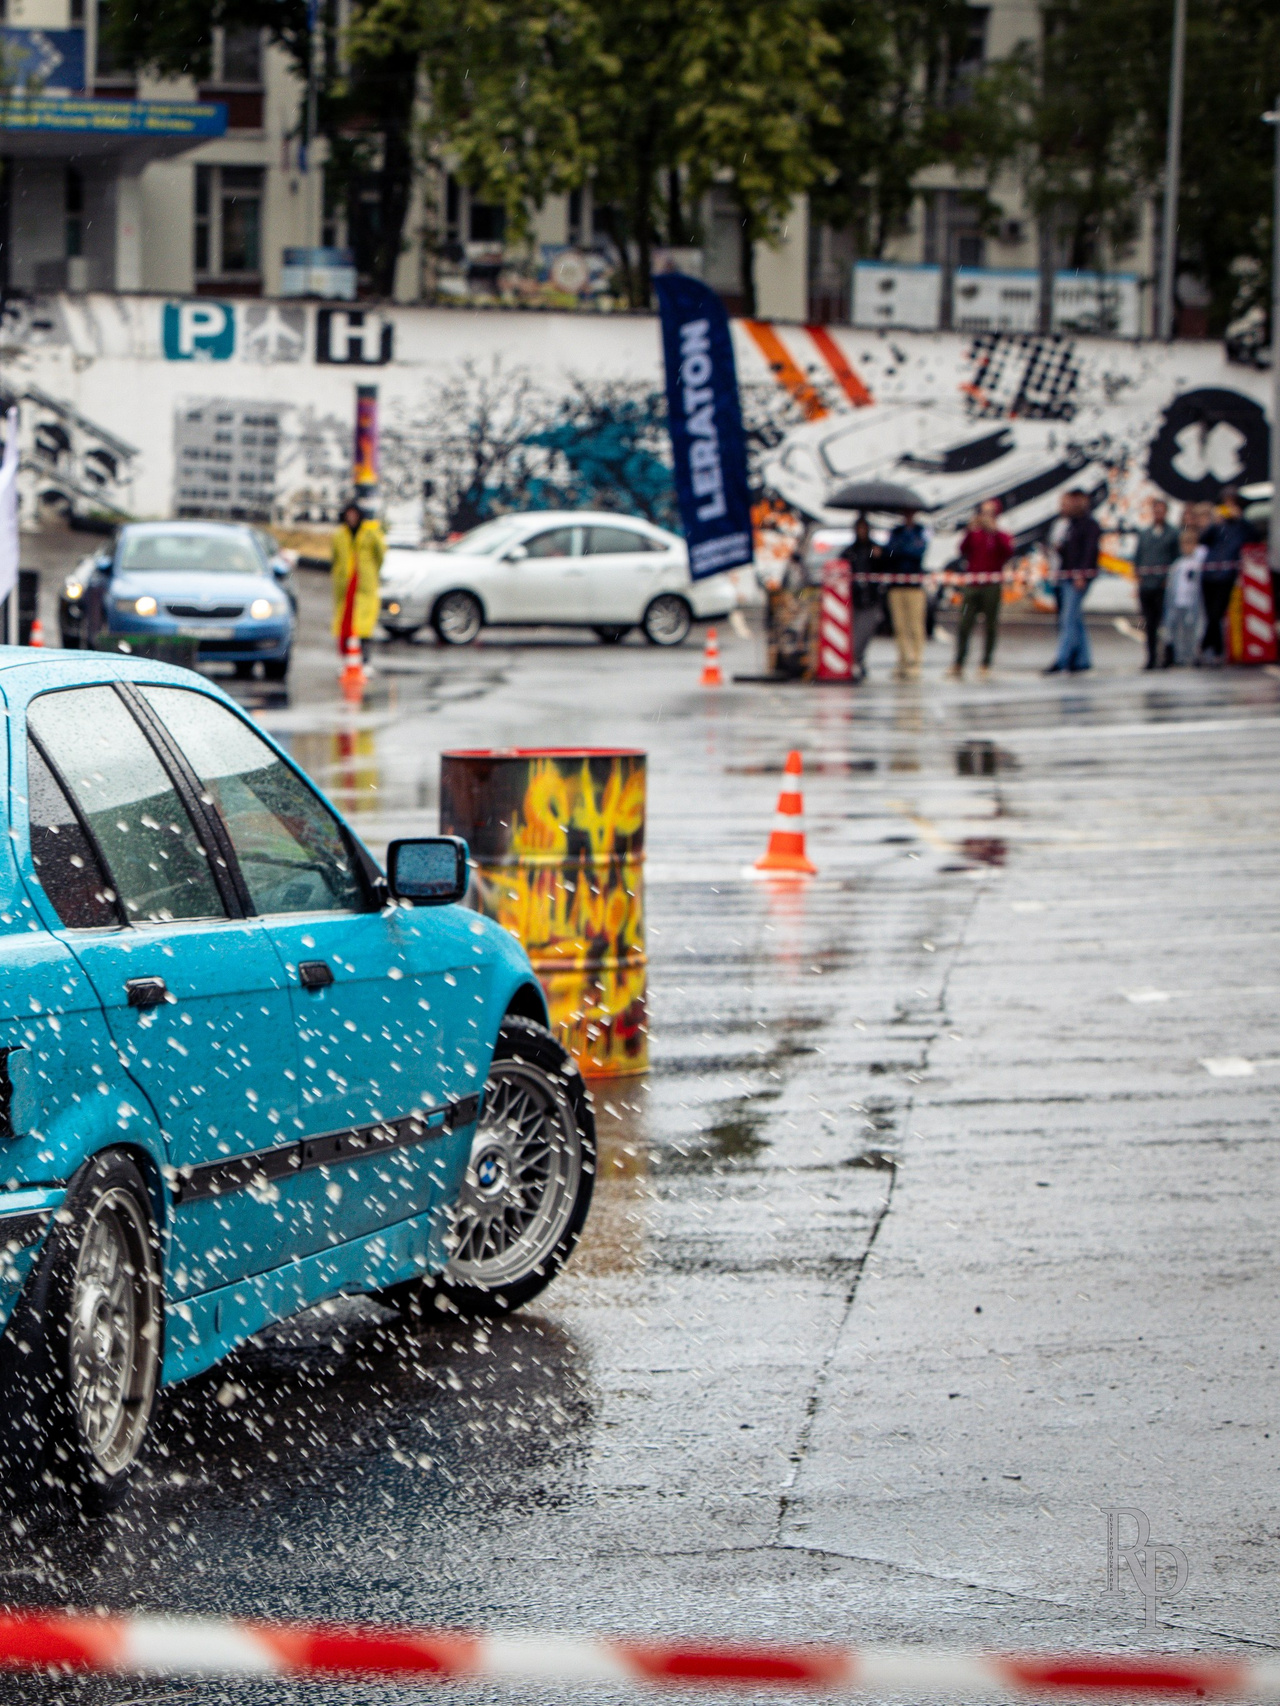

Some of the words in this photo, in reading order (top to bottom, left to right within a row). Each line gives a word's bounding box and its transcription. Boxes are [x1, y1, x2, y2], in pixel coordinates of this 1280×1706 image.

[177, 302, 228, 355] P
[328, 312, 381, 362] H
[679, 317, 727, 522] LERATON
